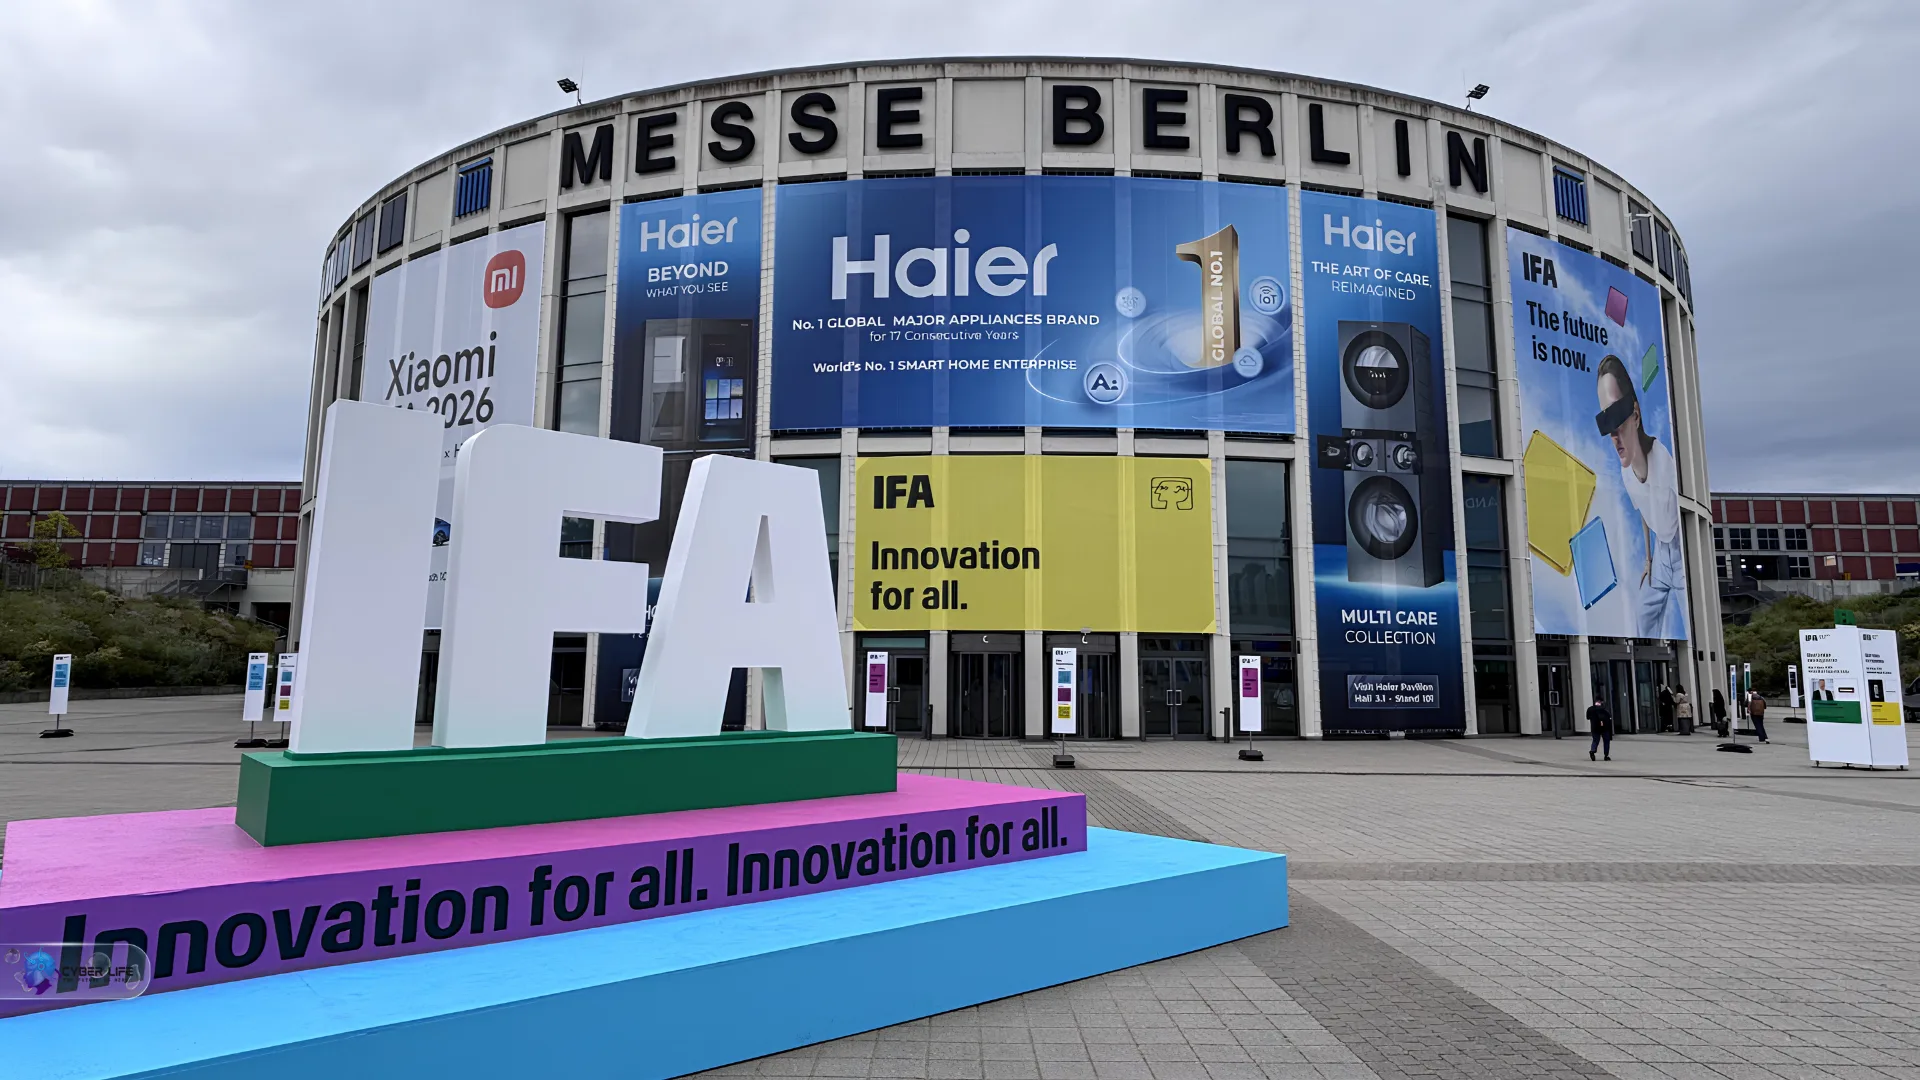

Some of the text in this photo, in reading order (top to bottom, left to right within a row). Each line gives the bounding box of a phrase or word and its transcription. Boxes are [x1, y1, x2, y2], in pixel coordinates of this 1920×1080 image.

[561, 84, 1488, 193] MESSE BERLIN
[640, 213, 738, 252] Haier
[1323, 214, 1416, 256] Haier
[648, 261, 729, 283] BEYOND
[831, 228, 1058, 300] Haier
[1311, 261, 1339, 275] THE
[1343, 265, 1370, 277] ART
[1374, 268, 1392, 280] OF
[1522, 252, 1558, 288] IFA
[646, 281, 729, 298] WHAT YOU SEE
[1210, 250, 1225, 361] GLOBAL NO.1
[1331, 280, 1416, 301] REIMAGINED
[792, 314, 1100, 330] No. 1 GLOBAL MAJOR APPLIANCES BRAND
[869, 329, 1020, 342] for 17 Consecutive Years
[1526, 300, 1608, 346] The future
[385, 331, 497, 400] Xiaomi
[813, 359, 1077, 373] World's No. 1 SMART HOME ENTERPRISE
[1532, 335, 1591, 373] is now.
[873, 474, 935, 510] IFA
[871, 540, 1040, 570] Innovation
[289, 399, 852, 753] IFA
[870, 580, 968, 611] for all.
[1341, 609, 1438, 625] MULTI CARE
[1345, 630, 1436, 645] COLLECTION
[56, 805, 1068, 994] Innovation for all. Innovation for all.
